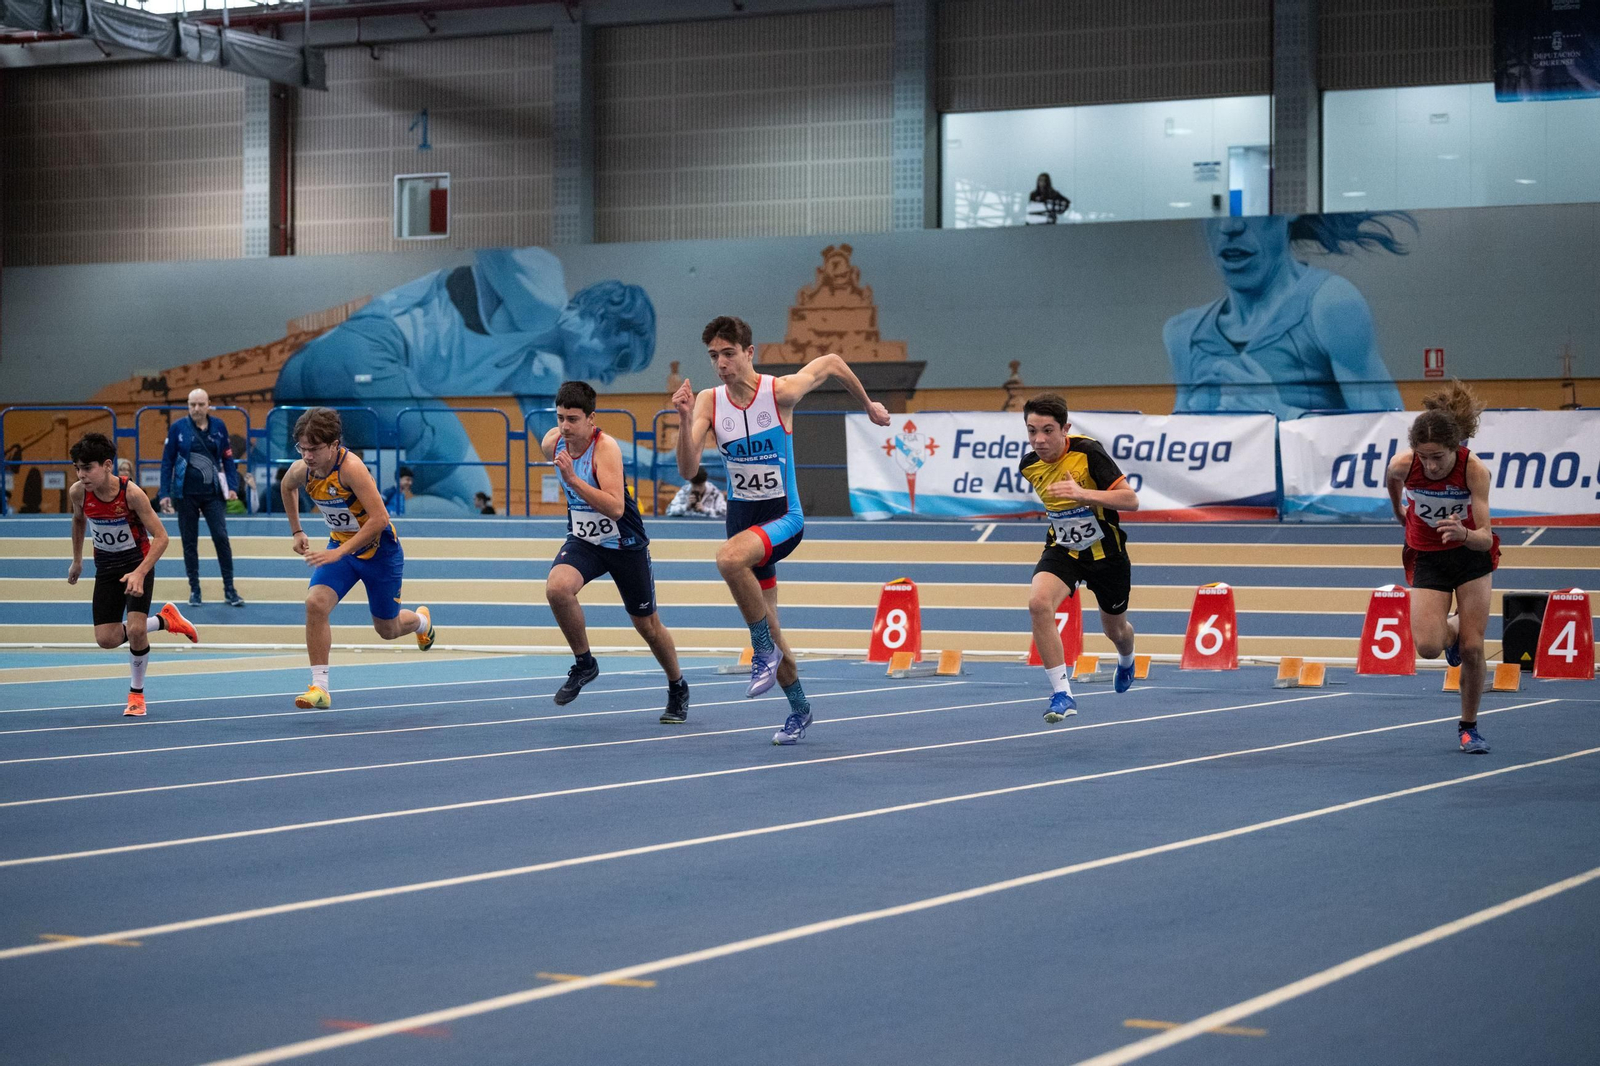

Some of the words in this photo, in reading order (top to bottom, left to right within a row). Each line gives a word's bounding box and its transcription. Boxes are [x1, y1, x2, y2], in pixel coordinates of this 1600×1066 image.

[1540, 58, 1574, 66] OURENSE
[1112, 433, 1232, 470] Galega
[734, 471, 778, 490] 245
[953, 472, 983, 494] de
[1420, 504, 1463, 519] 248
[93, 529, 129, 545] 306
[576, 518, 613, 537] 328
[1059, 523, 1096, 543] 263
[882, 609, 907, 649] 8
[1195, 614, 1223, 656] 6
[1371, 618, 1402, 660] 5
[1547, 620, 1579, 663] 4
